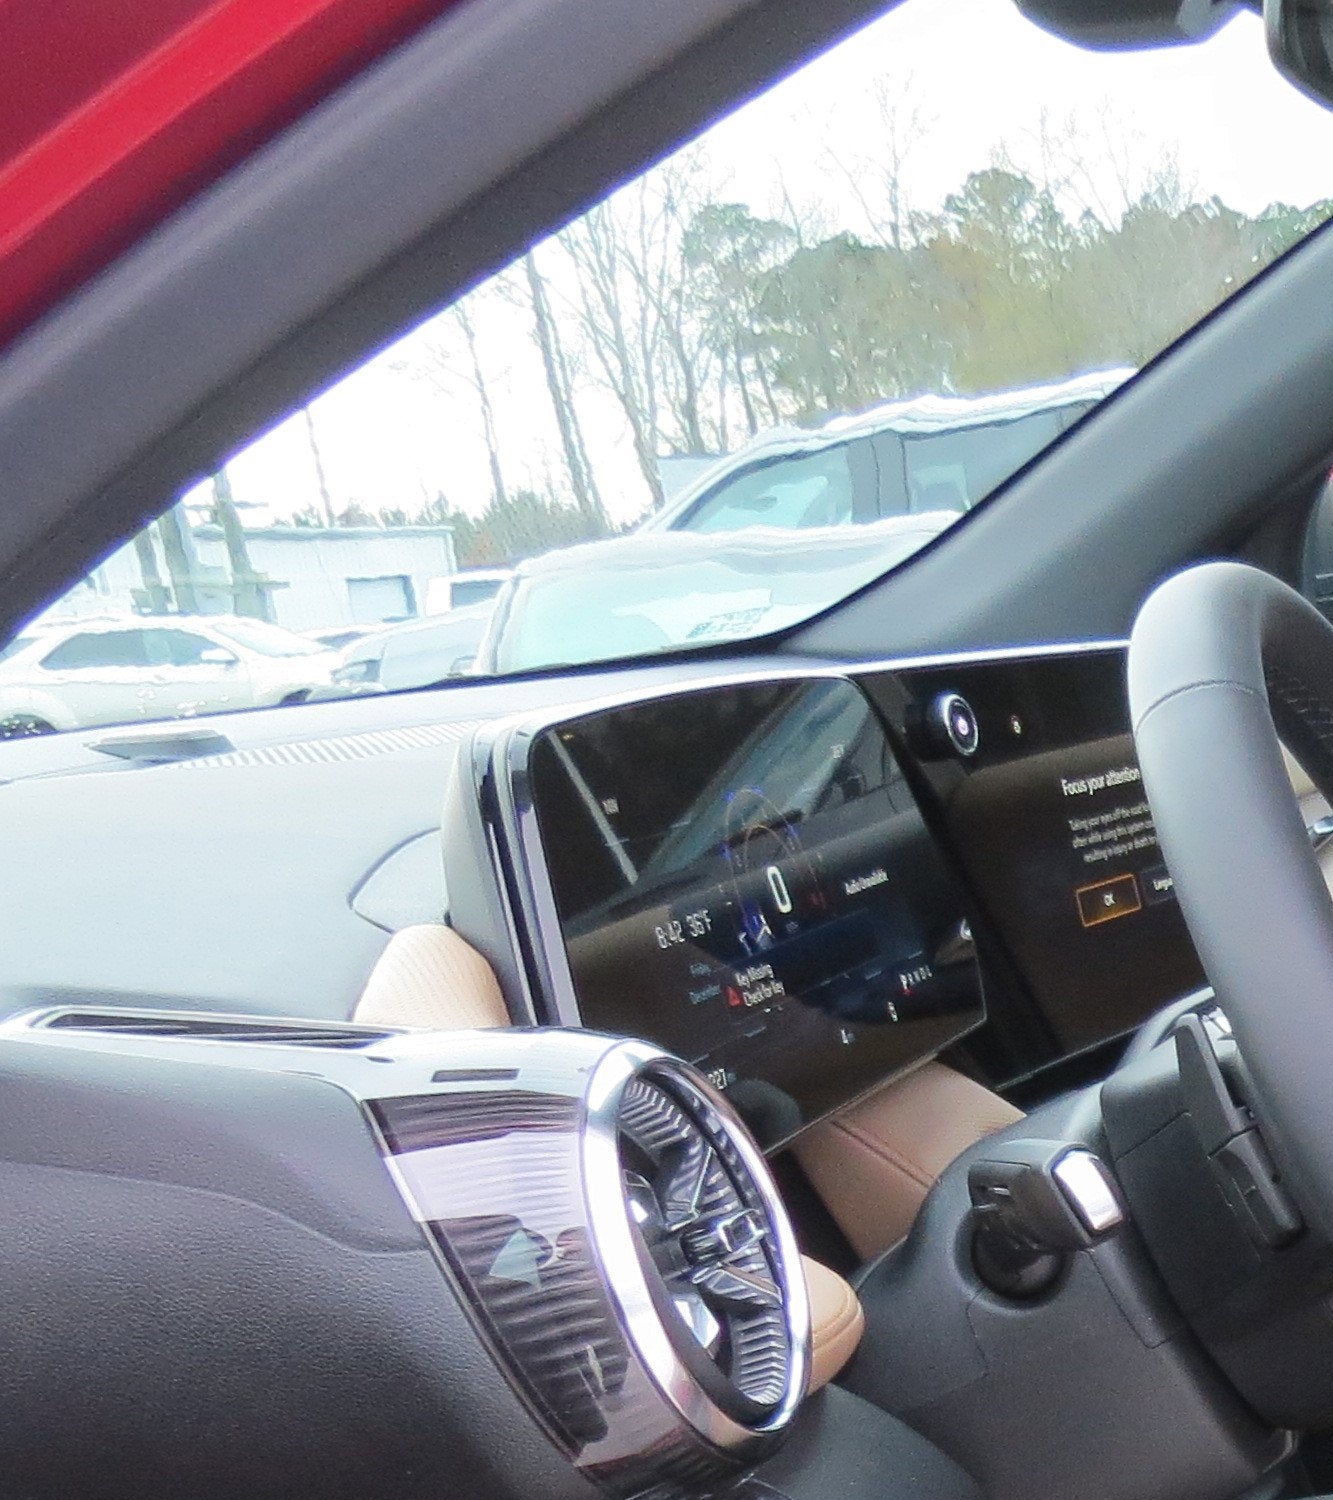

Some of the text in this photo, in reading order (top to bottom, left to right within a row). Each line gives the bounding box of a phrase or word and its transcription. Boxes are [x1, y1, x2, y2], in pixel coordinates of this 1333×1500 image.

[1061, 778, 1087, 797] Focus
[1086, 775, 1105, 797] your
[767, 866, 793, 915] 0
